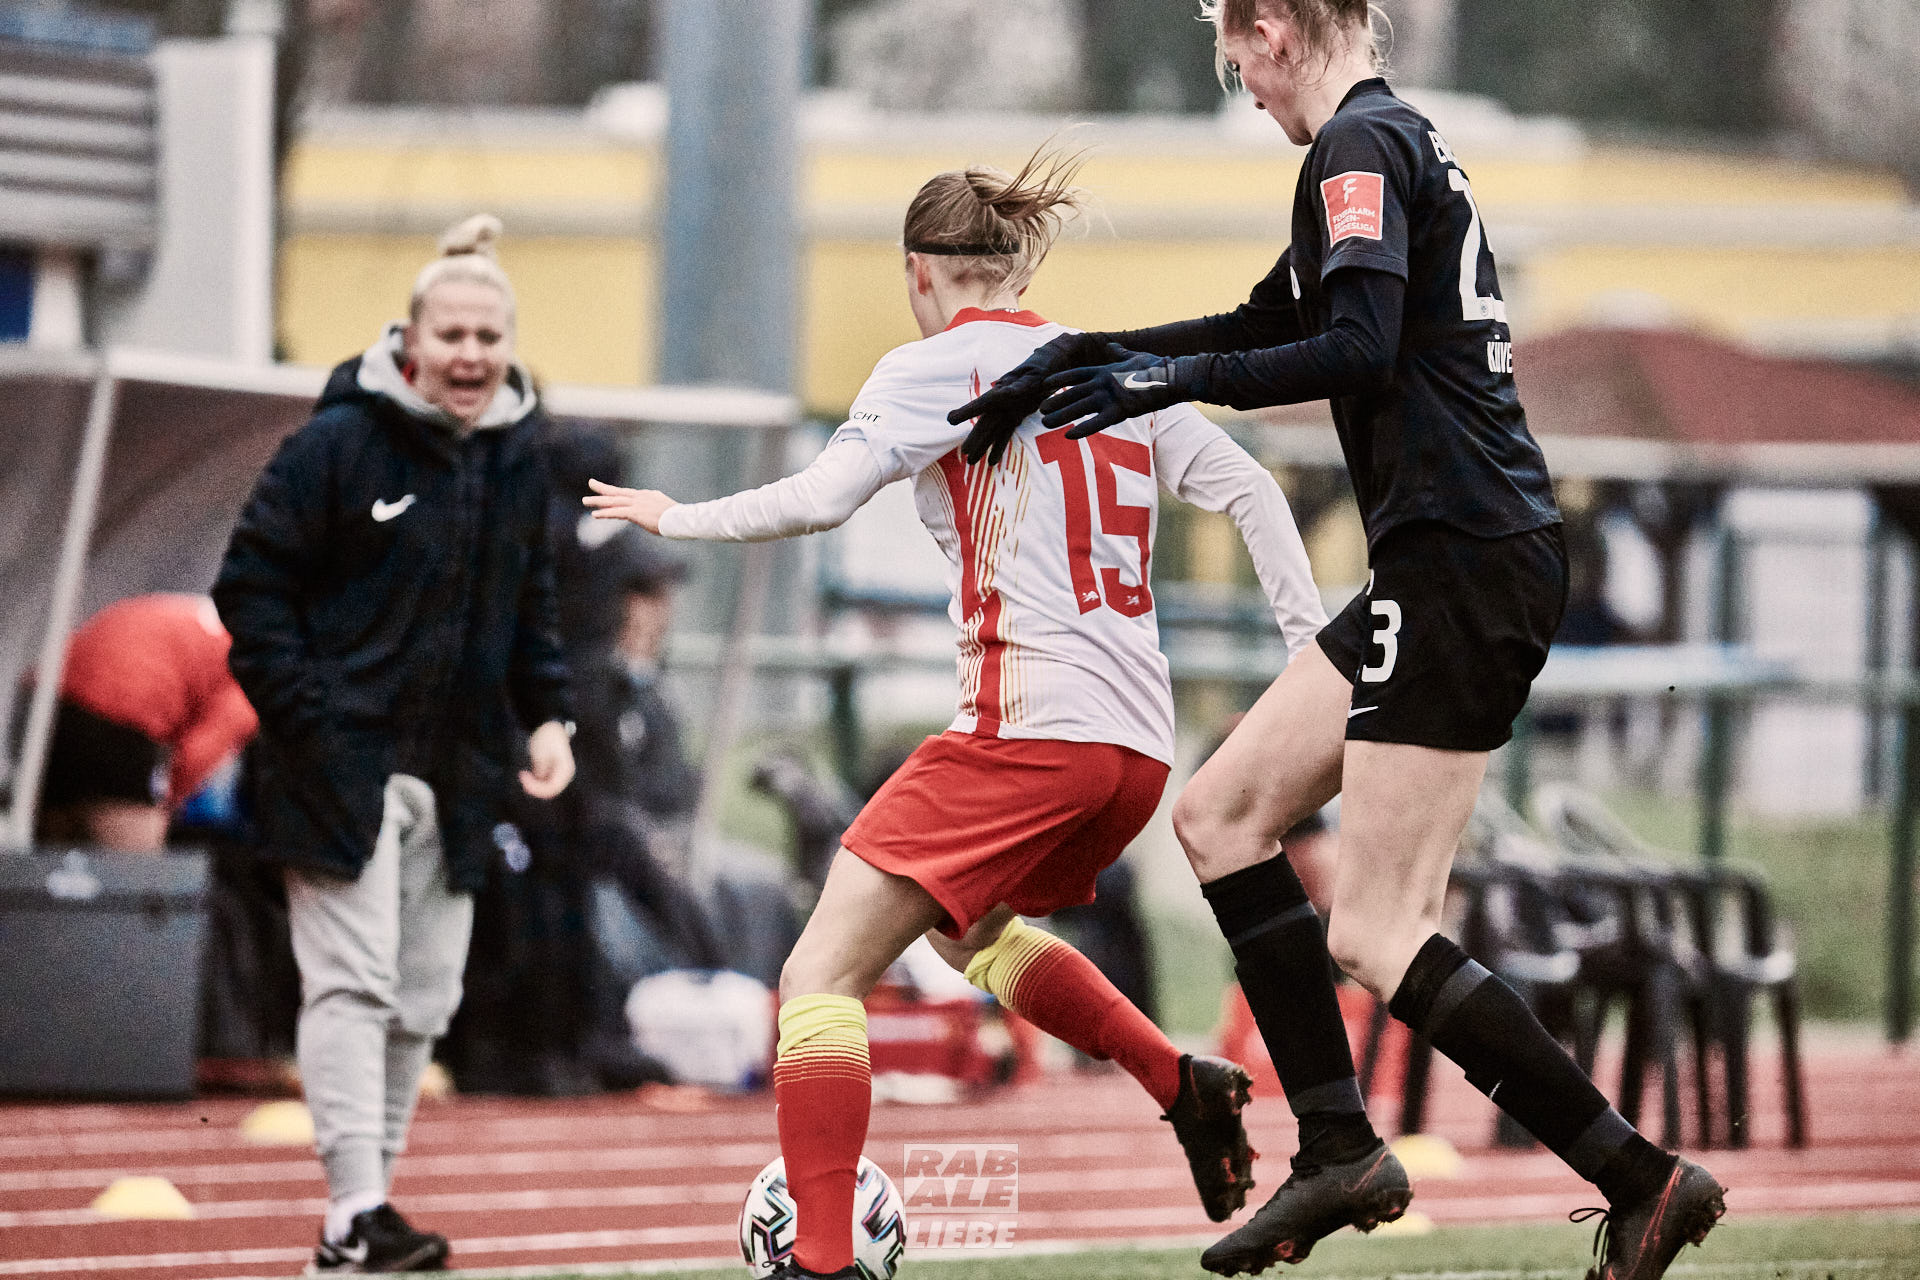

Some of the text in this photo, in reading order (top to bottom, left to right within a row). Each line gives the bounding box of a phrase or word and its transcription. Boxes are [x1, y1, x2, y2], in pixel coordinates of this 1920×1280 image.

[1334, 222, 1375, 238] DESLIGA
[1447, 168, 1508, 323] 2
[1035, 423, 1153, 618] 15
